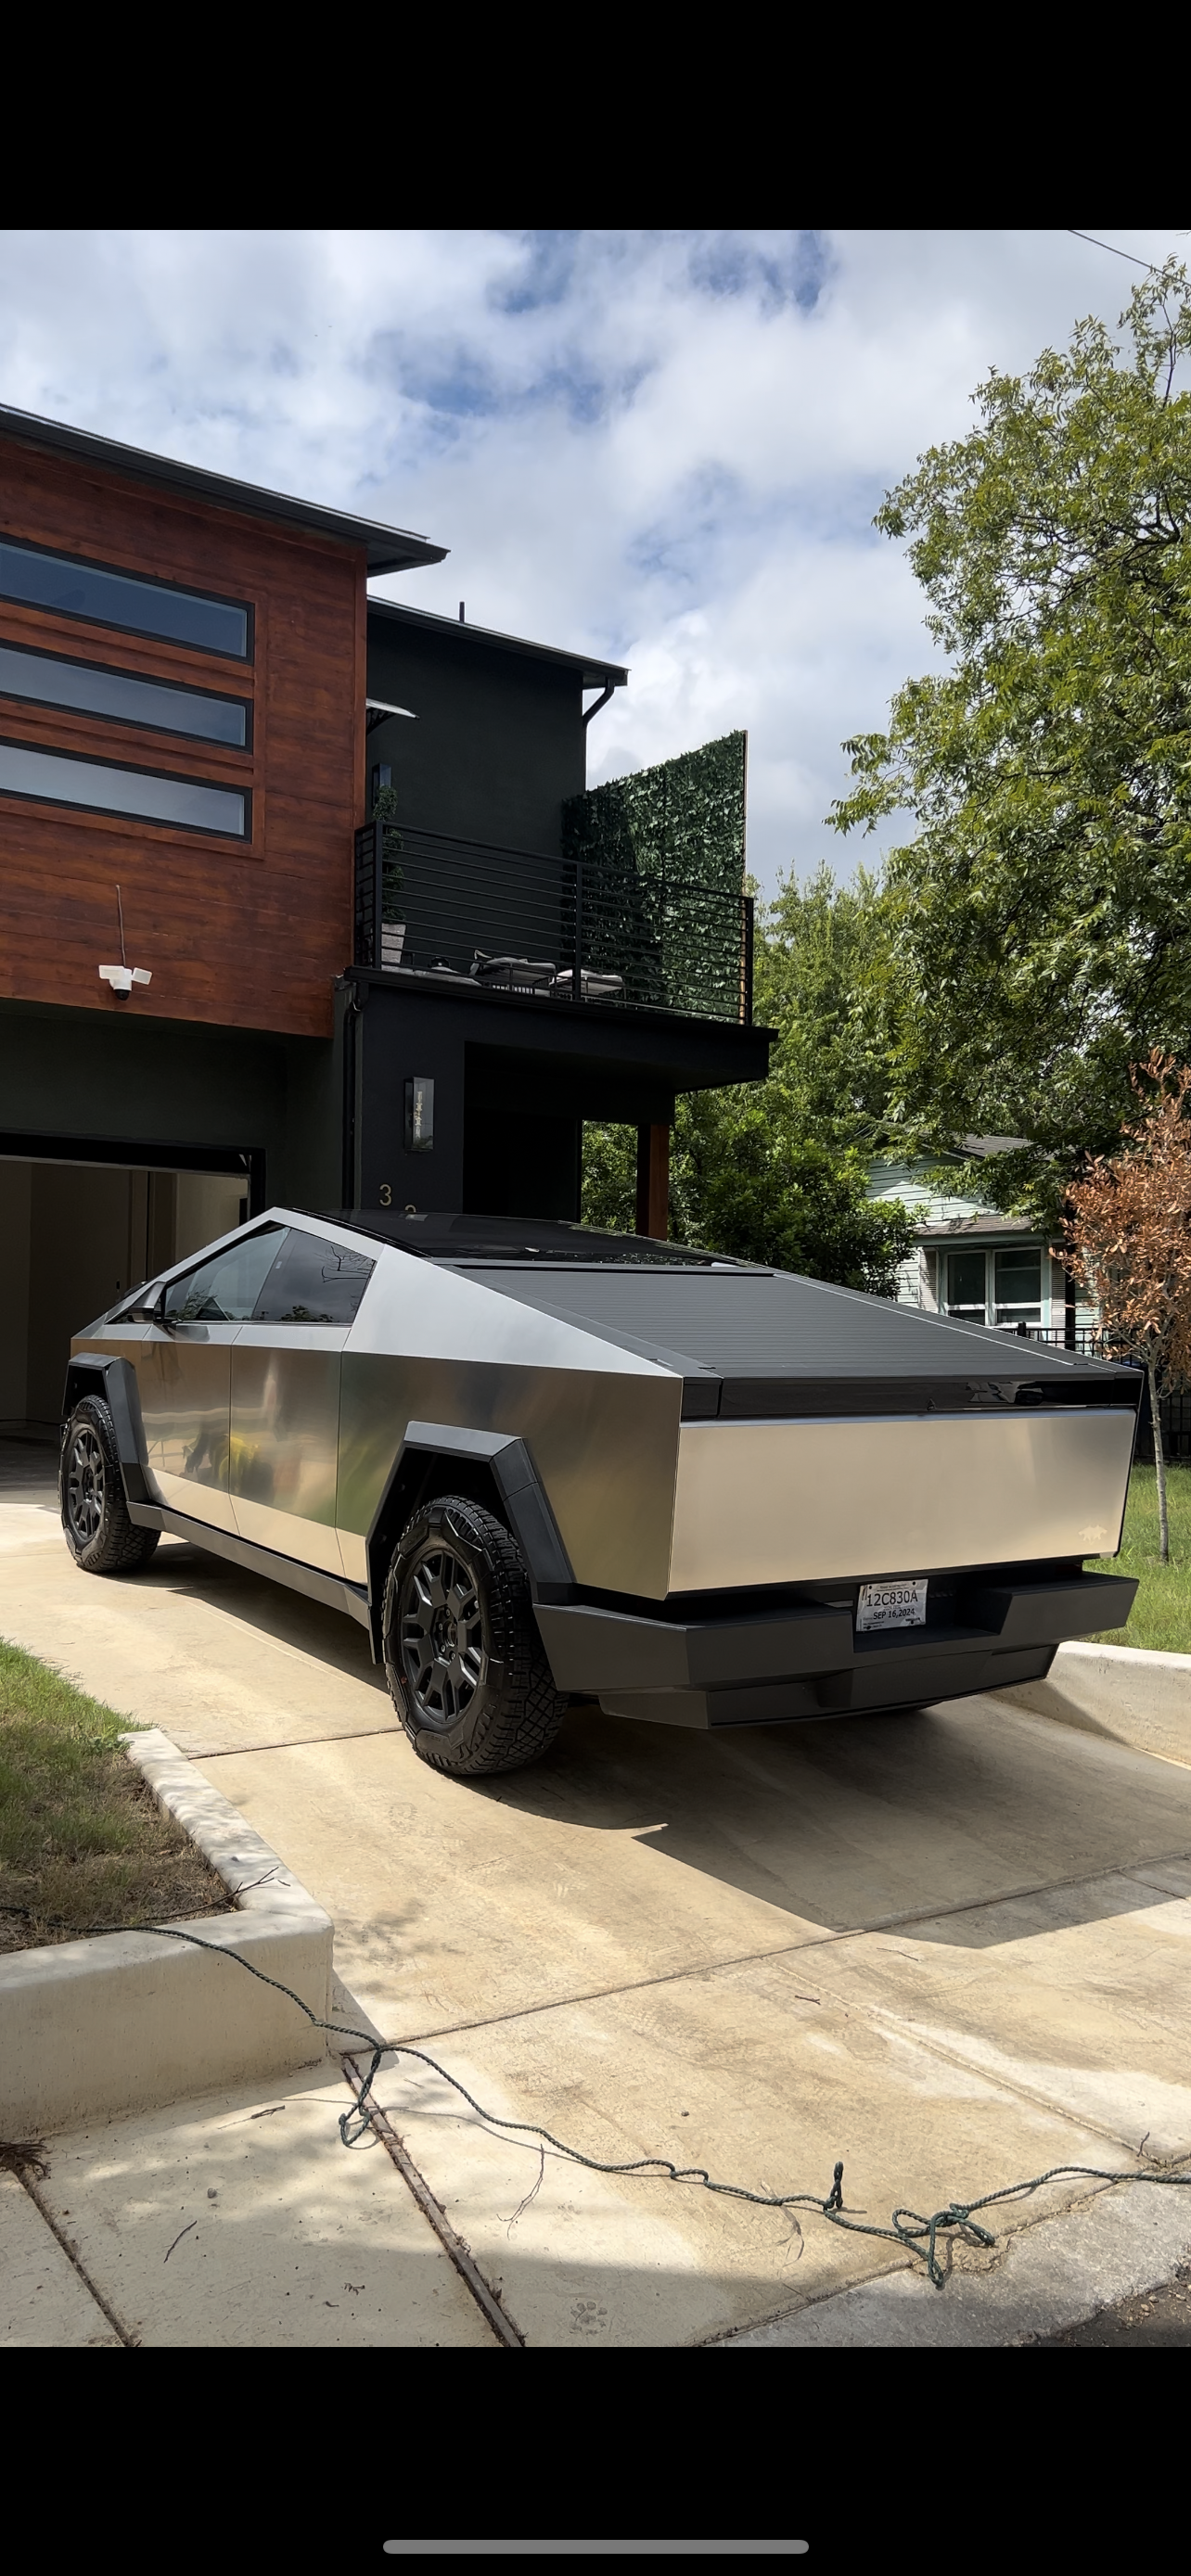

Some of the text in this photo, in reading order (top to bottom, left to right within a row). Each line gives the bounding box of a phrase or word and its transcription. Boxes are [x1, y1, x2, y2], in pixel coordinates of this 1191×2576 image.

[379, 1184, 392, 1206] 3
[866, 1590, 918, 1607] 12C830A
[873, 1611, 886, 1620] SEP
